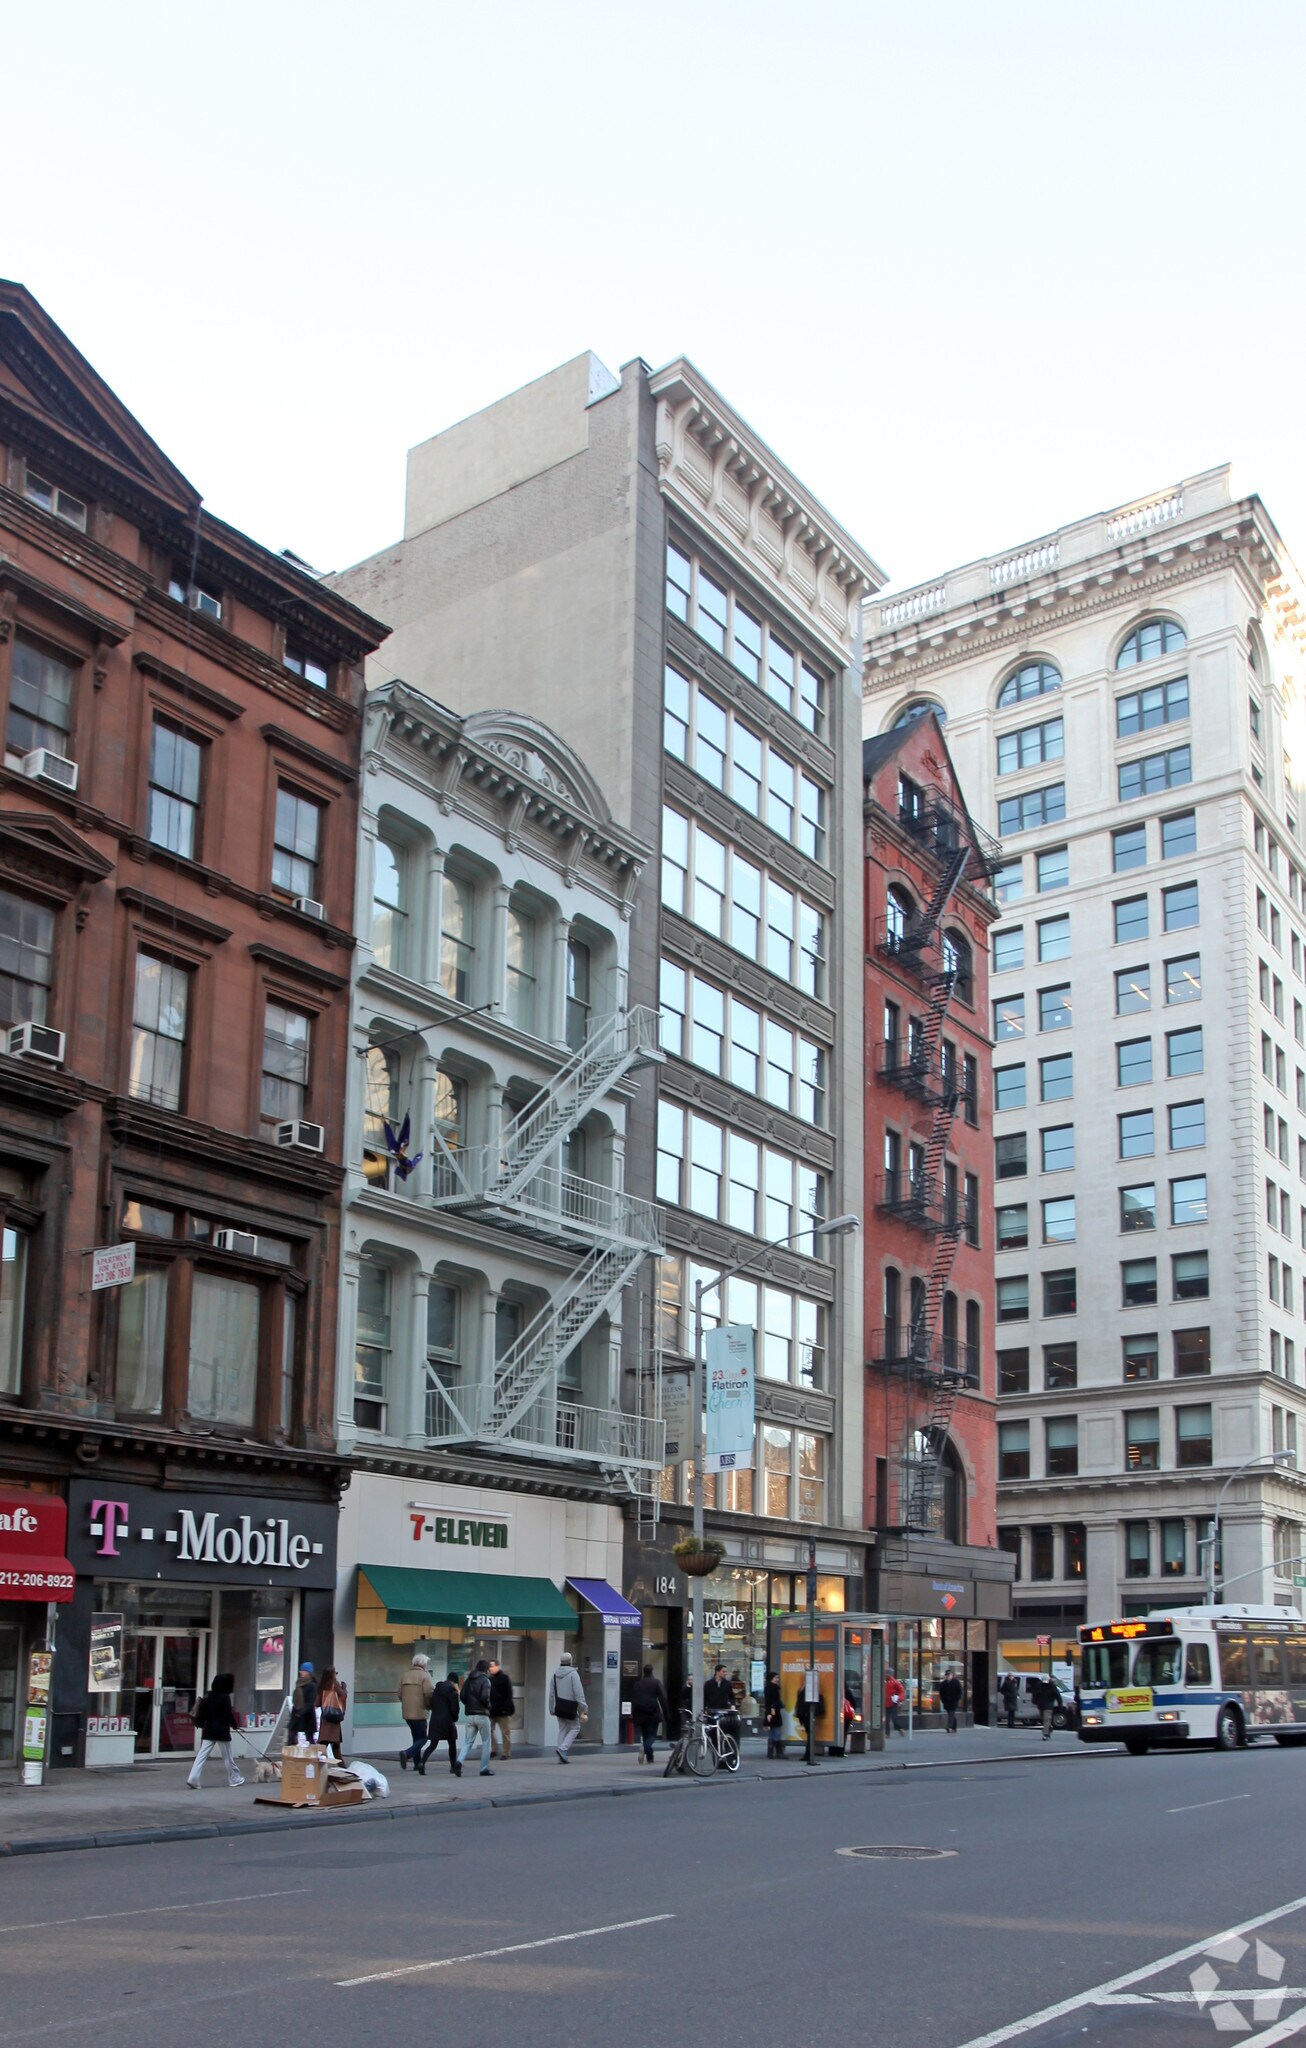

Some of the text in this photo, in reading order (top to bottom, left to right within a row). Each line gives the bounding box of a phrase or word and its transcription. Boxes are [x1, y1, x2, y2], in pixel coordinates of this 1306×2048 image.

[712, 1370, 724, 1381] 23
[711, 1380, 749, 1391] Flatiron
[0, 1572, 74, 1588] 212-206-8922
[656, 1576, 676, 1594] 184
[262, 1636, 285, 1654] 4G
